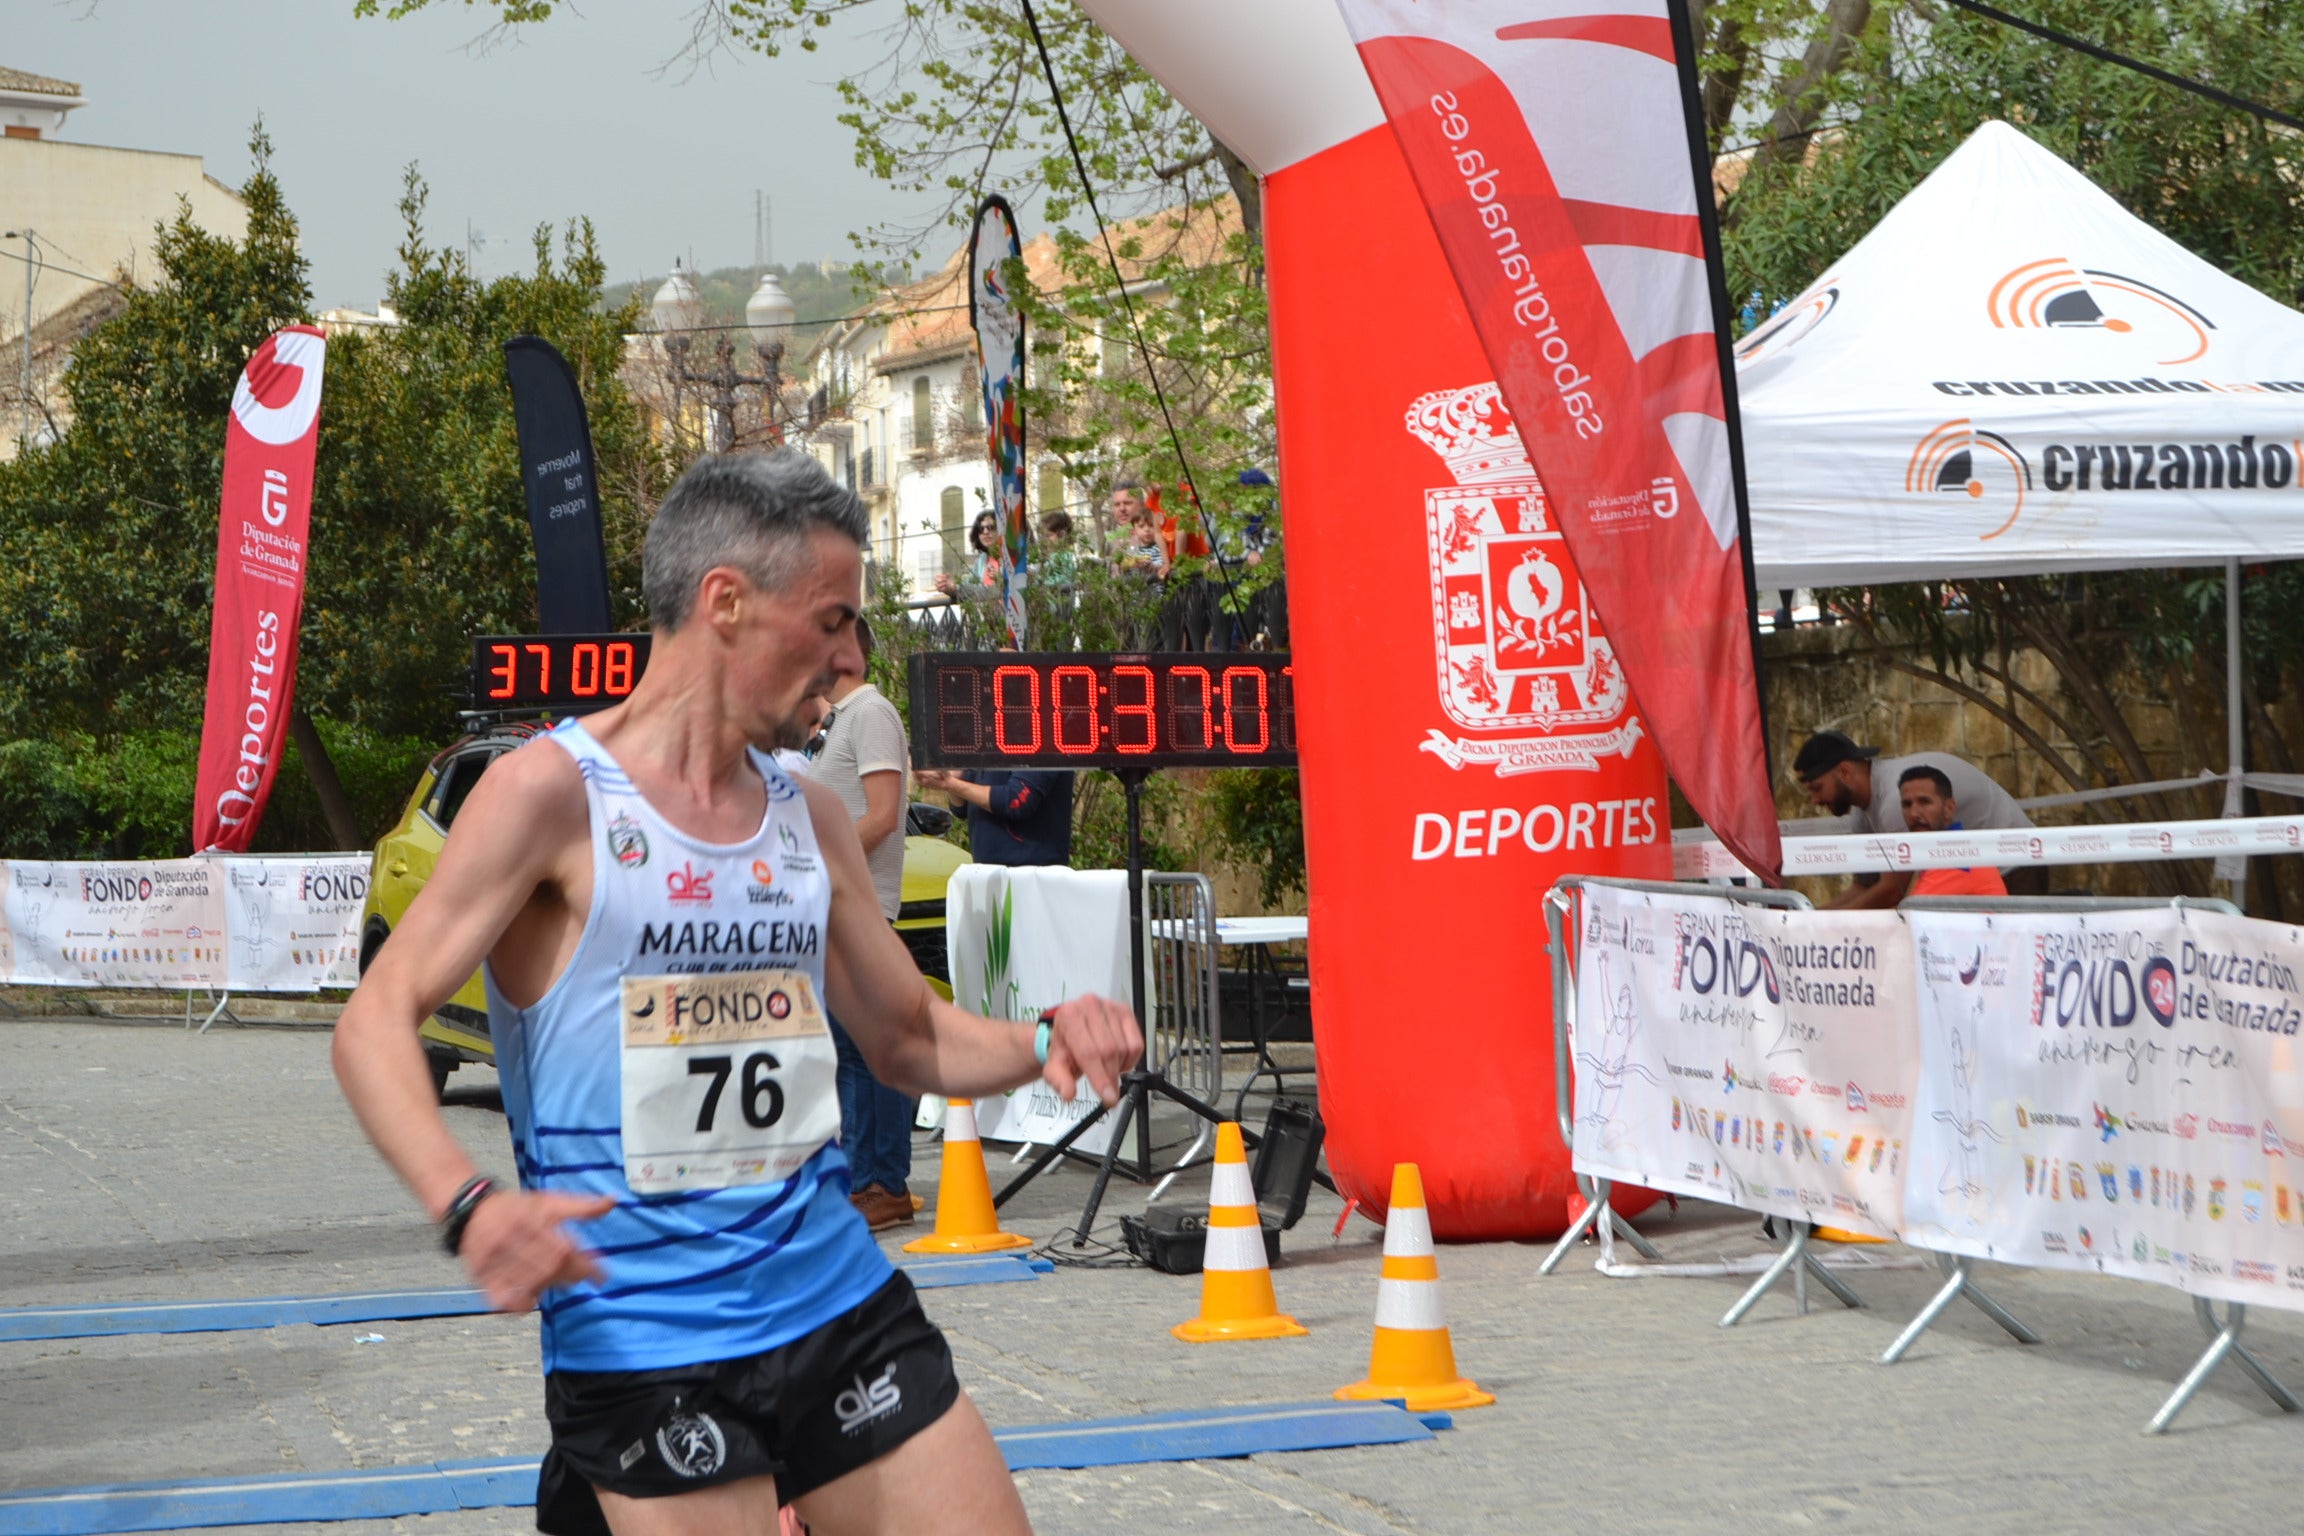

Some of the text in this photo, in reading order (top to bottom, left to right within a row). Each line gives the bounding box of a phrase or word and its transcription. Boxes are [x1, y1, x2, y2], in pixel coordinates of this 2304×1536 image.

[242, 520, 301, 554] Diputación
[240, 541, 299, 573] de Granada
[489, 642, 634, 698] 37 08
[993, 665, 1298, 755] 00:37:0
[1508, 752, 1586, 766] GRANADA
[1412, 797, 1656, 860] DEPORTES
[85, 876, 152, 901] FONDO
[154, 870, 208, 884] Diputación
[154, 885, 209, 897] de Granada
[305, 874, 371, 901] FOND
[639, 921, 818, 956] MARACENA
[1679, 911, 1717, 938] GRAN
[2042, 932, 2088, 962] GRAN
[708, 961, 729, 974] DE
[1678, 935, 1781, 1005] FONDO
[675, 989, 792, 1026] FONDO
[1794, 975, 1876, 1008] Granada
[2039, 956, 2178, 1028] FONDO
[2151, 979, 2174, 1008] 24
[2180, 983, 2209, 1020] de
[688, 1052, 785, 1133] 76
